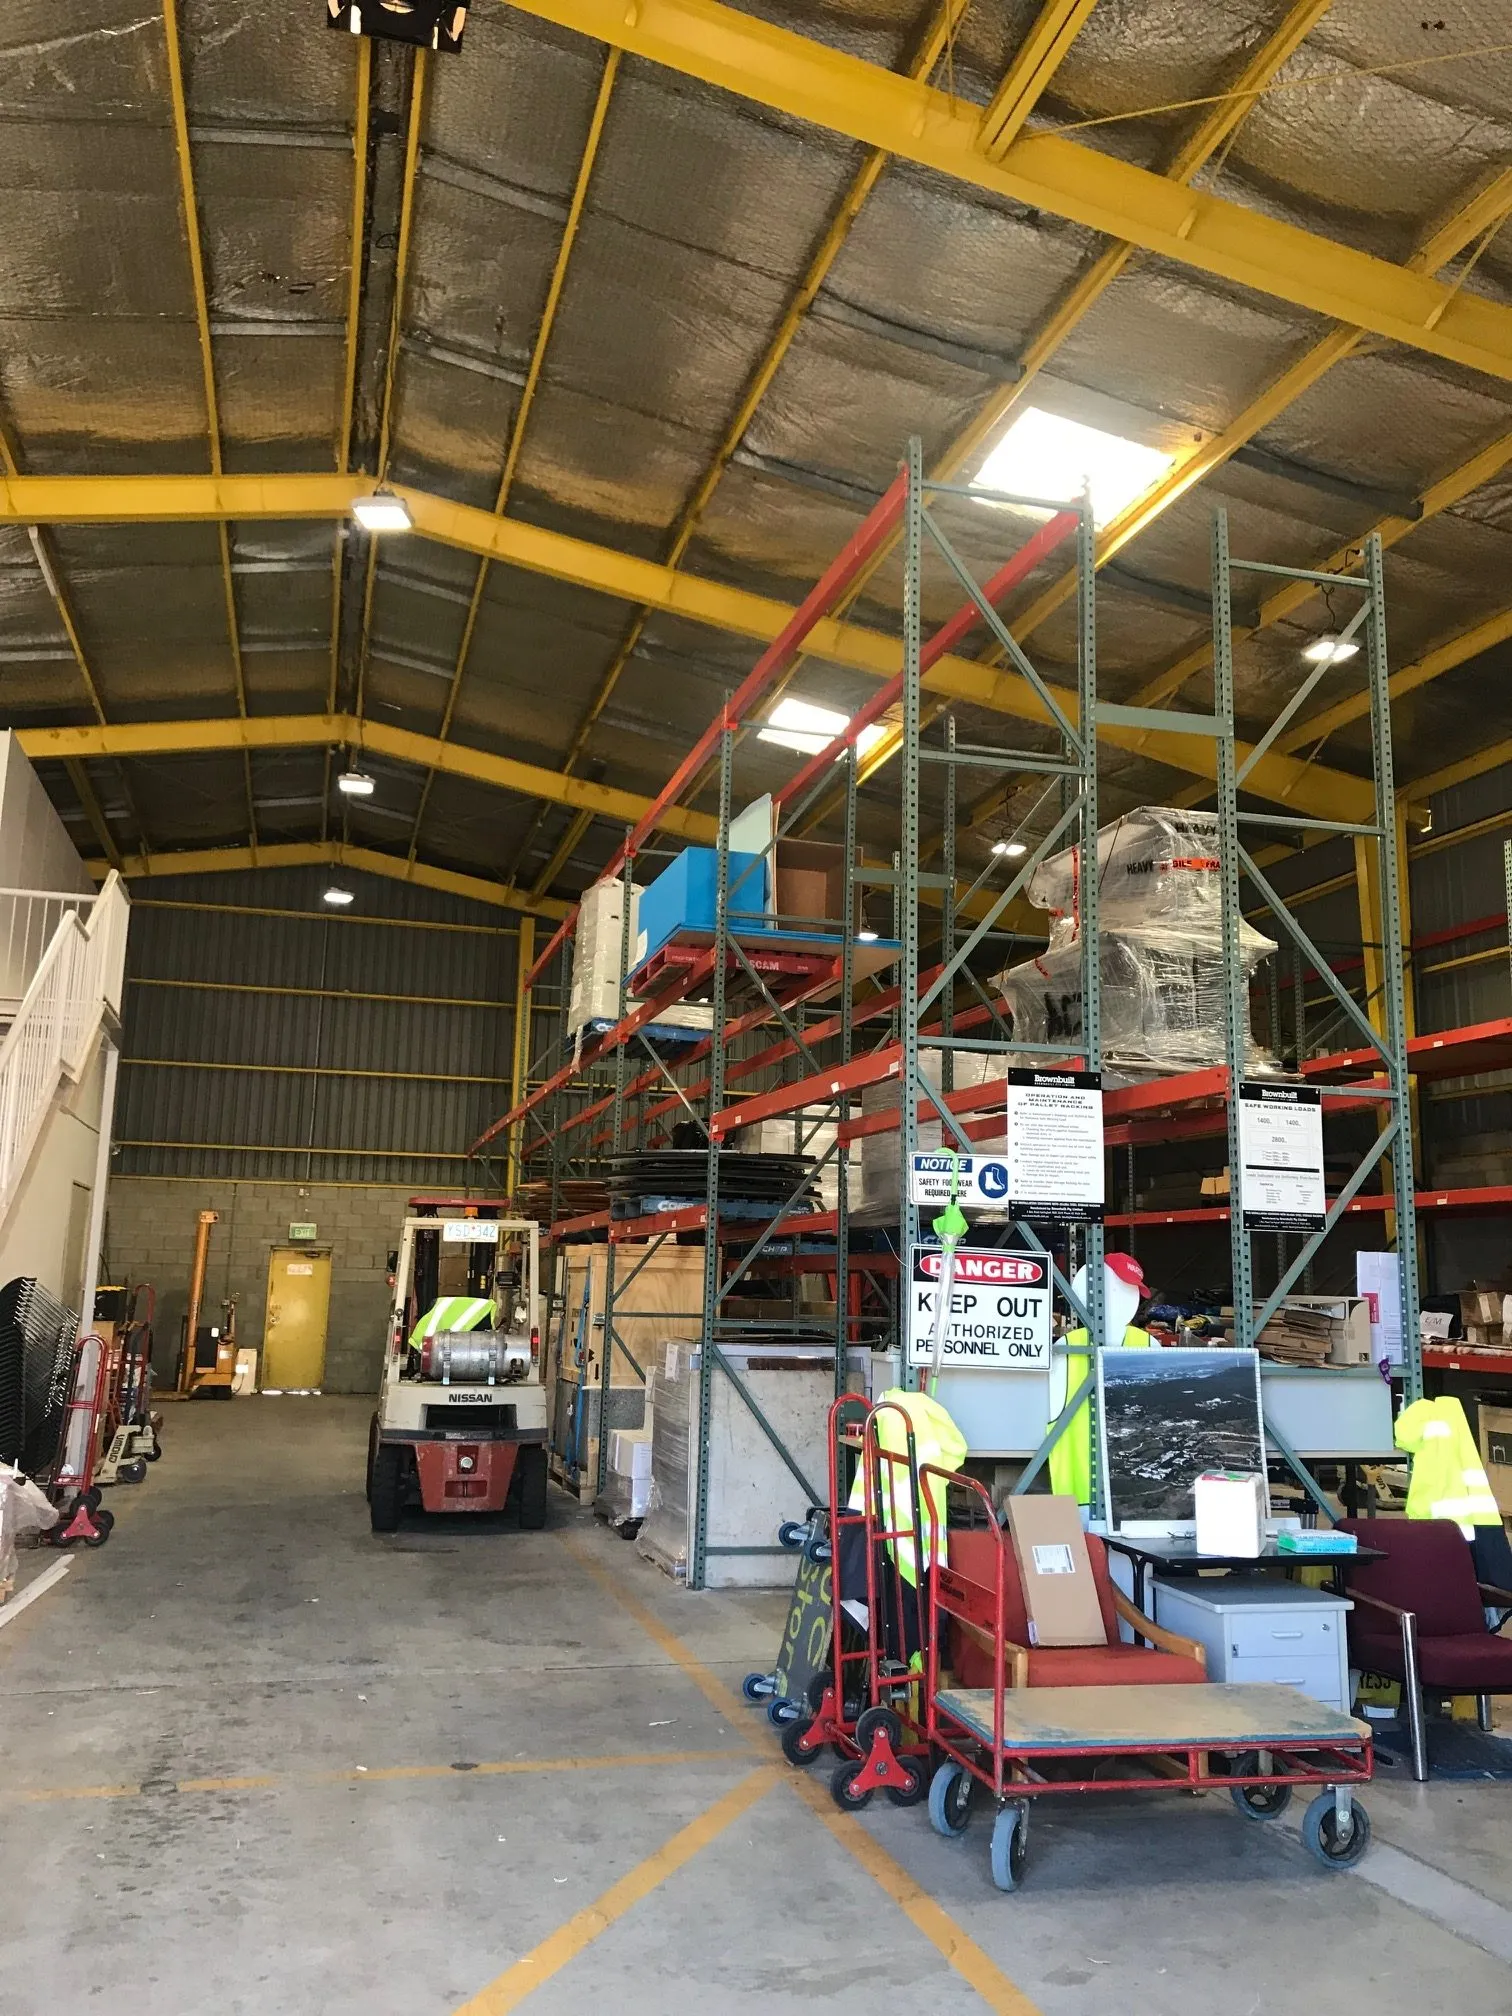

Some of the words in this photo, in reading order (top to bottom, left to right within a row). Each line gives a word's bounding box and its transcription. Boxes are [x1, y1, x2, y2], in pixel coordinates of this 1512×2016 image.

[1126, 860, 1154, 875] HEAVY
[735, 958, 780, 971] LSCAM
[1034, 1074, 1075, 1084] Brownbuilt
[1261, 1089, 1298, 1099] Brownbuilt
[920, 1158, 968, 1171] NOTIE
[918, 1178, 940, 1186] SAFETY
[942, 1179, 973, 1187] FOOWEAR
[924, 1188, 951, 1197] REQUIRED
[928, 1257, 1034, 1280] DANGER
[918, 1292, 978, 1314] KEP
[996, 1296, 1043, 1318] OUT
[928, 1322, 1034, 1341] ATHORIZED
[916, 1339, 1001, 1356] PESONNEL
[1008, 1342, 1044, 1358] ONLY
[448, 1393, 493, 1403] NISSAN
